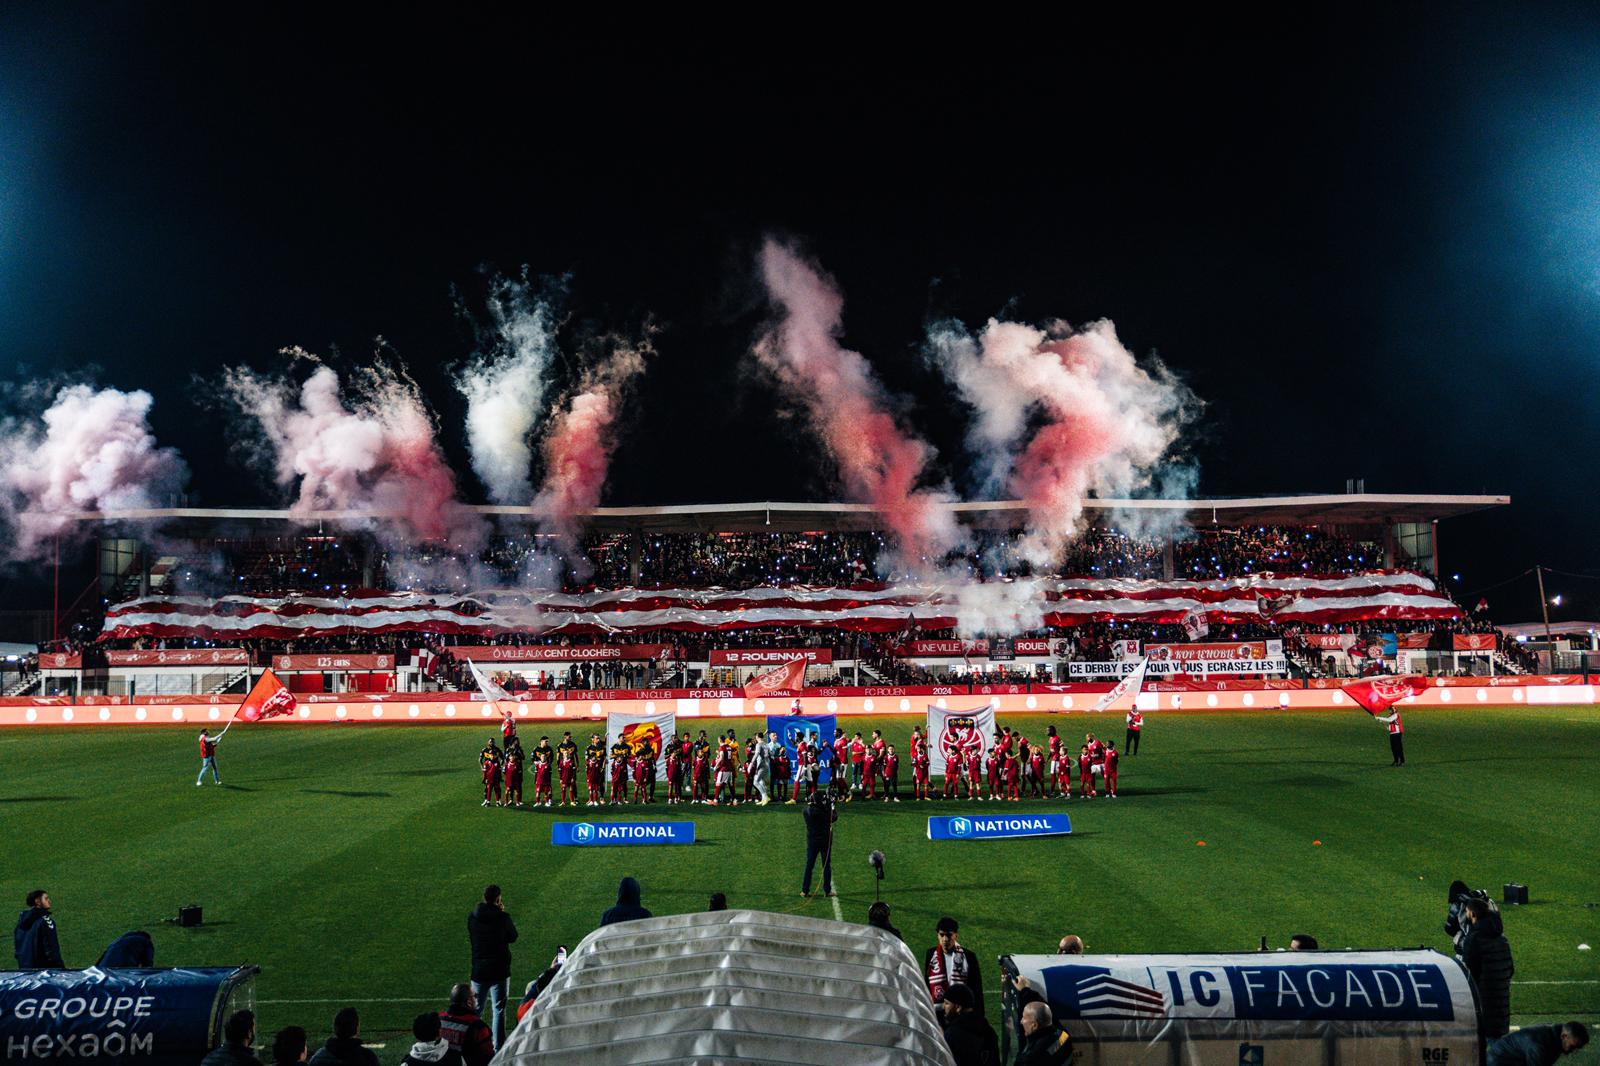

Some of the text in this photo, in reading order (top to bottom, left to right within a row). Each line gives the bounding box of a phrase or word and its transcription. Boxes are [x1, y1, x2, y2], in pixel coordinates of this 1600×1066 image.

[502, 649, 524, 658] VILLE
[525, 649, 542, 658] AUX
[544, 649, 569, 657] CENT
[571, 648, 621, 657] CLOCHERS
[917, 643, 936, 652] UNE
[1017, 642, 1050, 651] ROUEN
[317, 658, 350, 667] 125 ans
[725, 652, 817, 661] 12 ROUENNAIS
[1070, 664, 1082, 673] CE
[1085, 663, 1117, 673] DERBY
[1207, 662, 1252, 672] ECRASEZ
[1255, 661, 1274, 670] LES
[577, 691, 595, 699] UNE
[595, 691, 616, 699] VILLE
[636, 691, 649, 699] UN
[650, 690, 672, 699] CLUB
[689, 690, 701, 698] FC
[703, 690, 733, 698] ROUEN
[819, 688, 838, 697] 1899
[864, 687, 876, 696] FC
[877, 687, 906, 696] ROUEN
[932, 687, 952, 695] 2024
[975, 819, 1052, 831] NATIONAL
[598, 826, 676, 838] NATIONAL
[1166, 969, 1438, 1008] IC FACADE
[14, 996, 155, 1019] GROUPE
[1422, 1047, 1449, 1060] RGE
